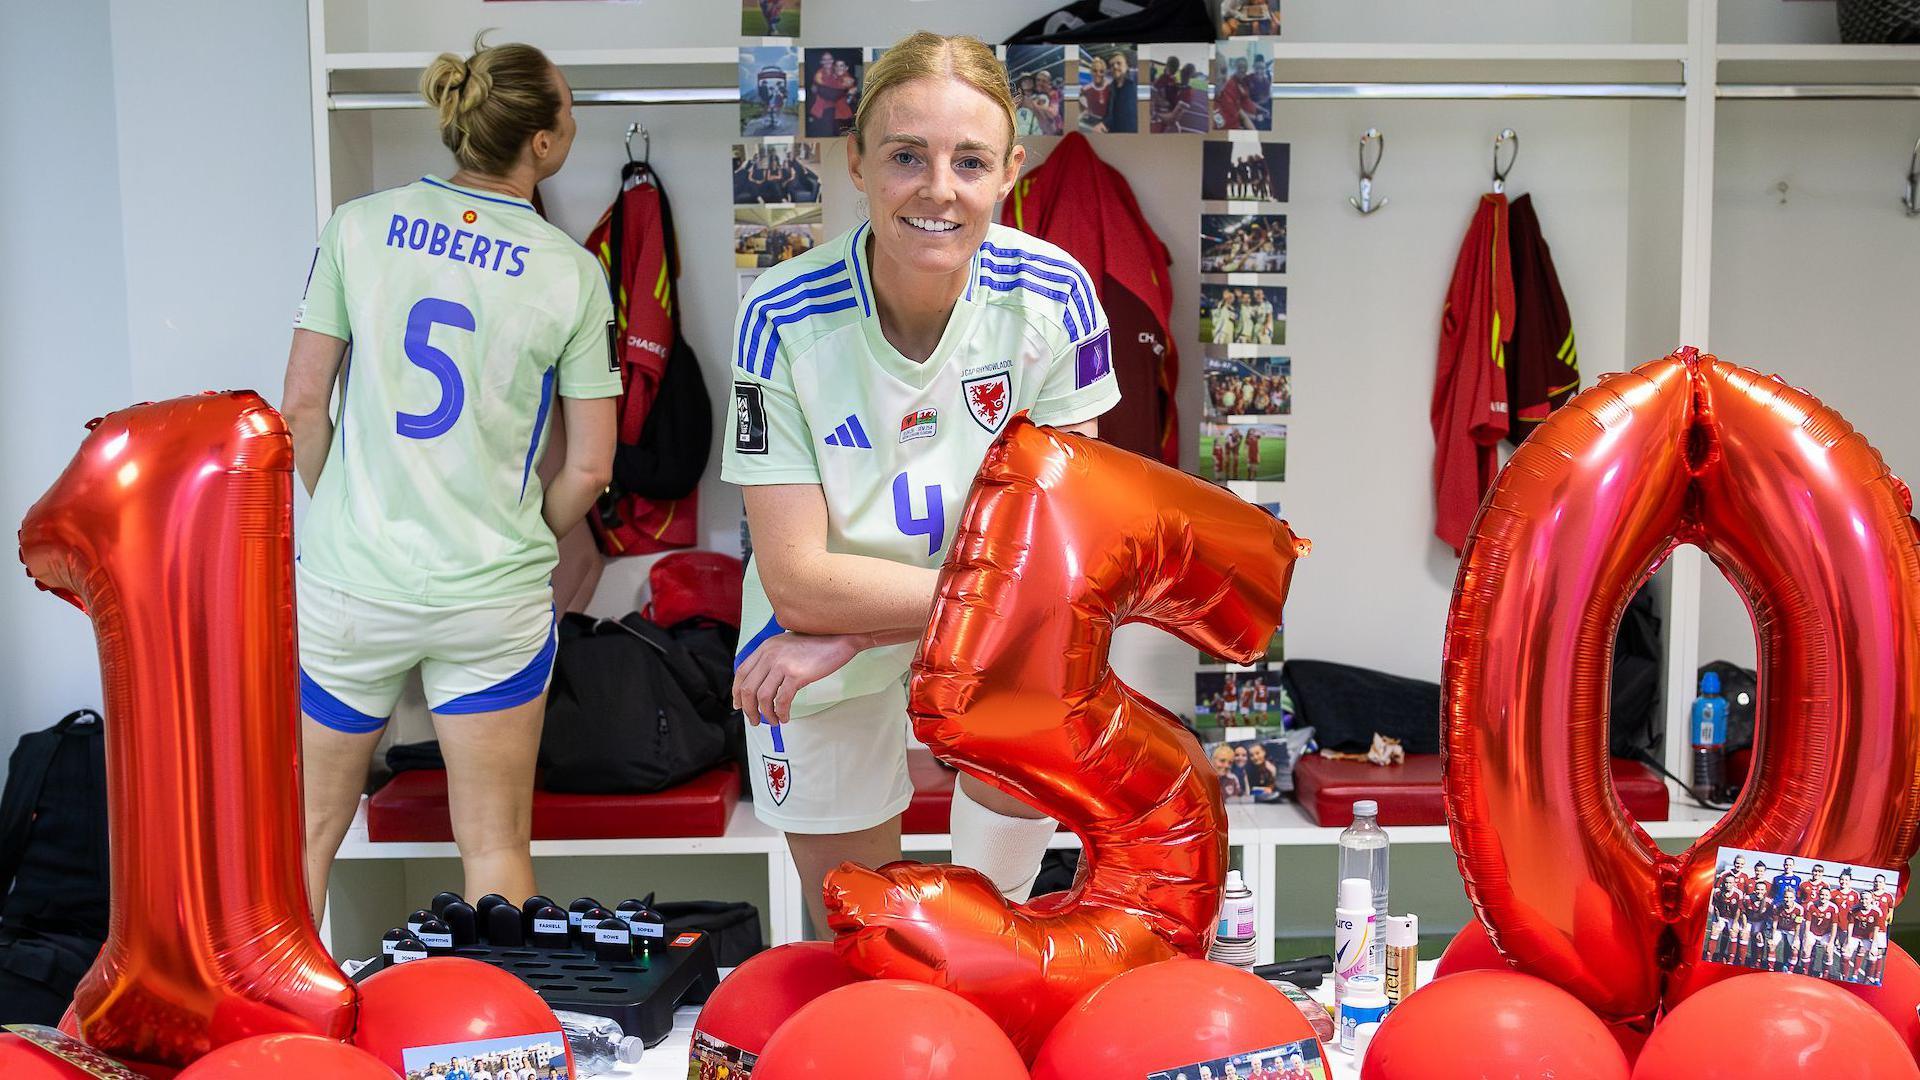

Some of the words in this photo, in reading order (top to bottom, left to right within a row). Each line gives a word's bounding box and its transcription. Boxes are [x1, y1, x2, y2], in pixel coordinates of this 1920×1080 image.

[386, 214, 531, 277] ROBERTS
[396, 297, 477, 440] 5
[892, 471, 945, 557] 4
